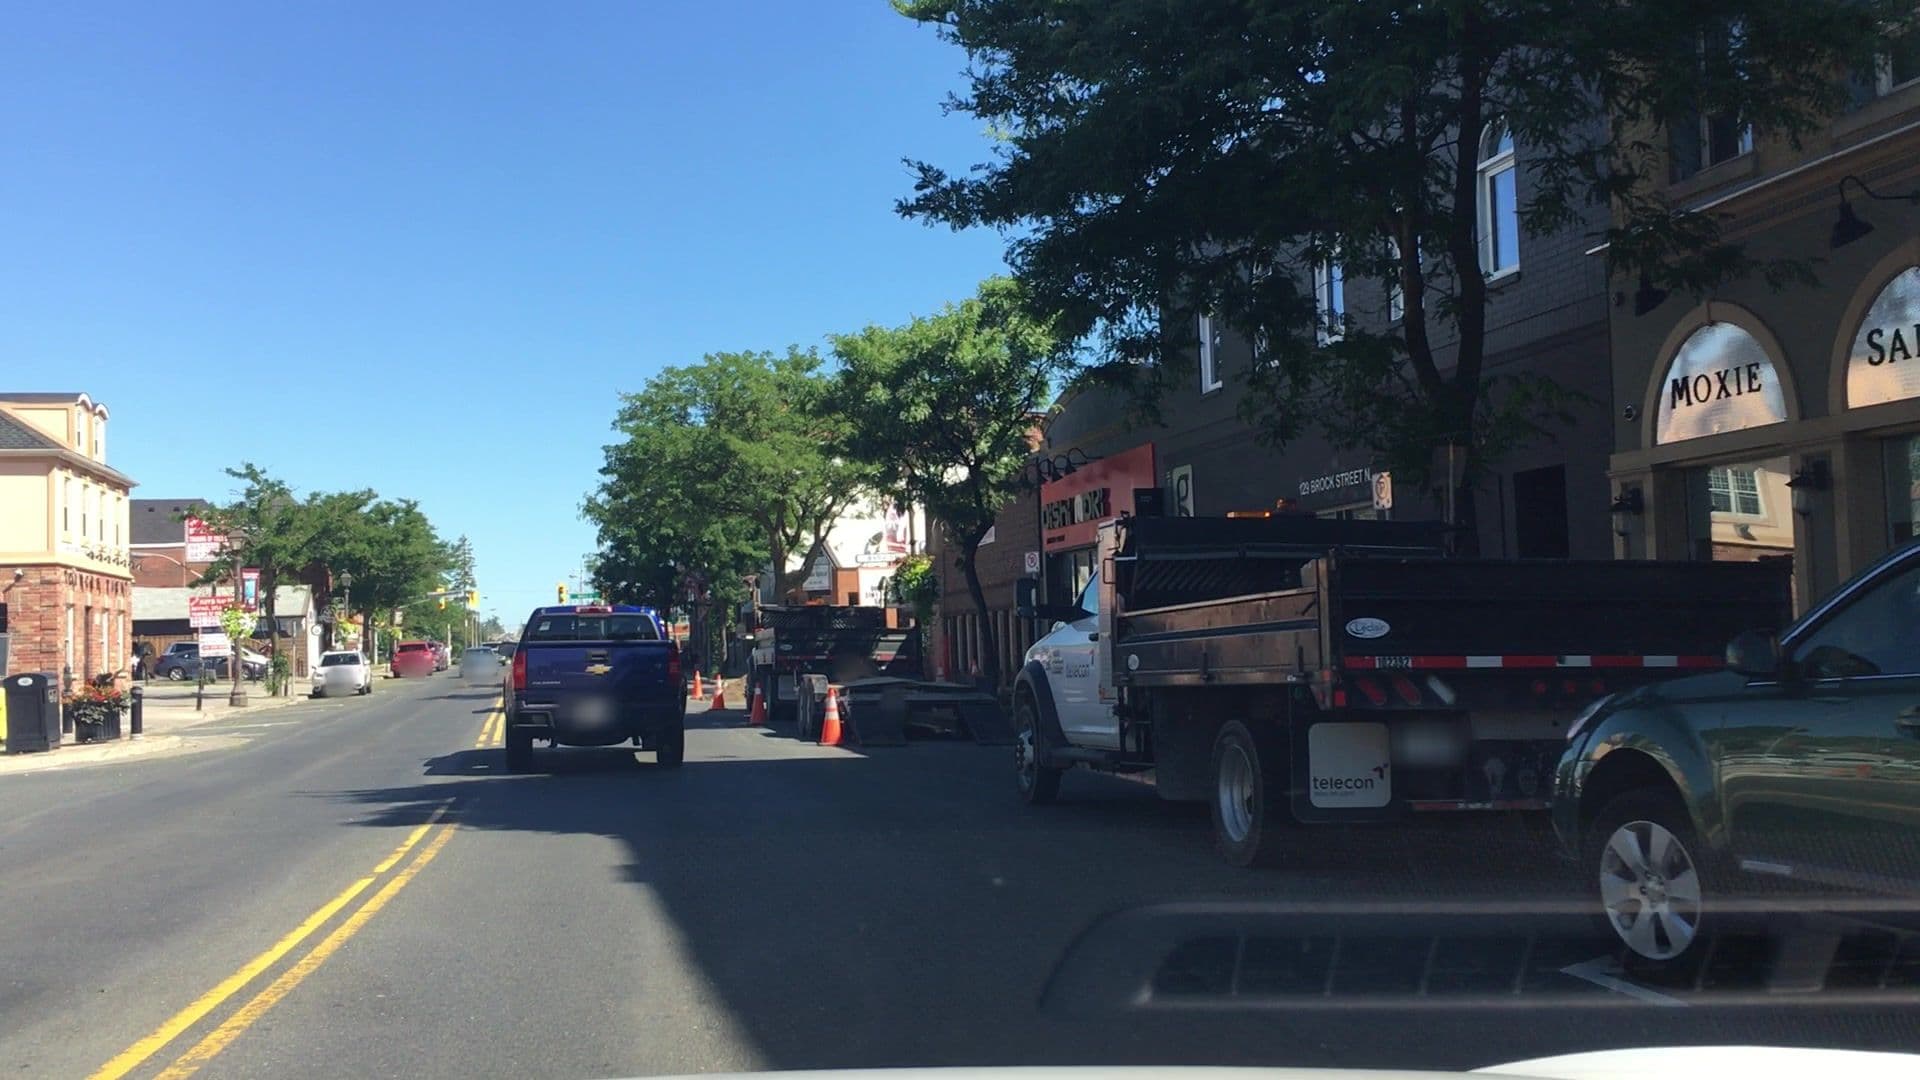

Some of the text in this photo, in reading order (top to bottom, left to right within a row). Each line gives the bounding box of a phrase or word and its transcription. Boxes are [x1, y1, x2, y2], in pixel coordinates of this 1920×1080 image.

[1866, 323, 1920, 366] SA
[1670, 362, 1763, 410] MOXIE
[1299, 480, 1310, 495] 129
[1310, 475, 1335, 494] BROCK
[1335, 468, 1364, 488] STREET
[1312, 776, 1374, 790] telecon
